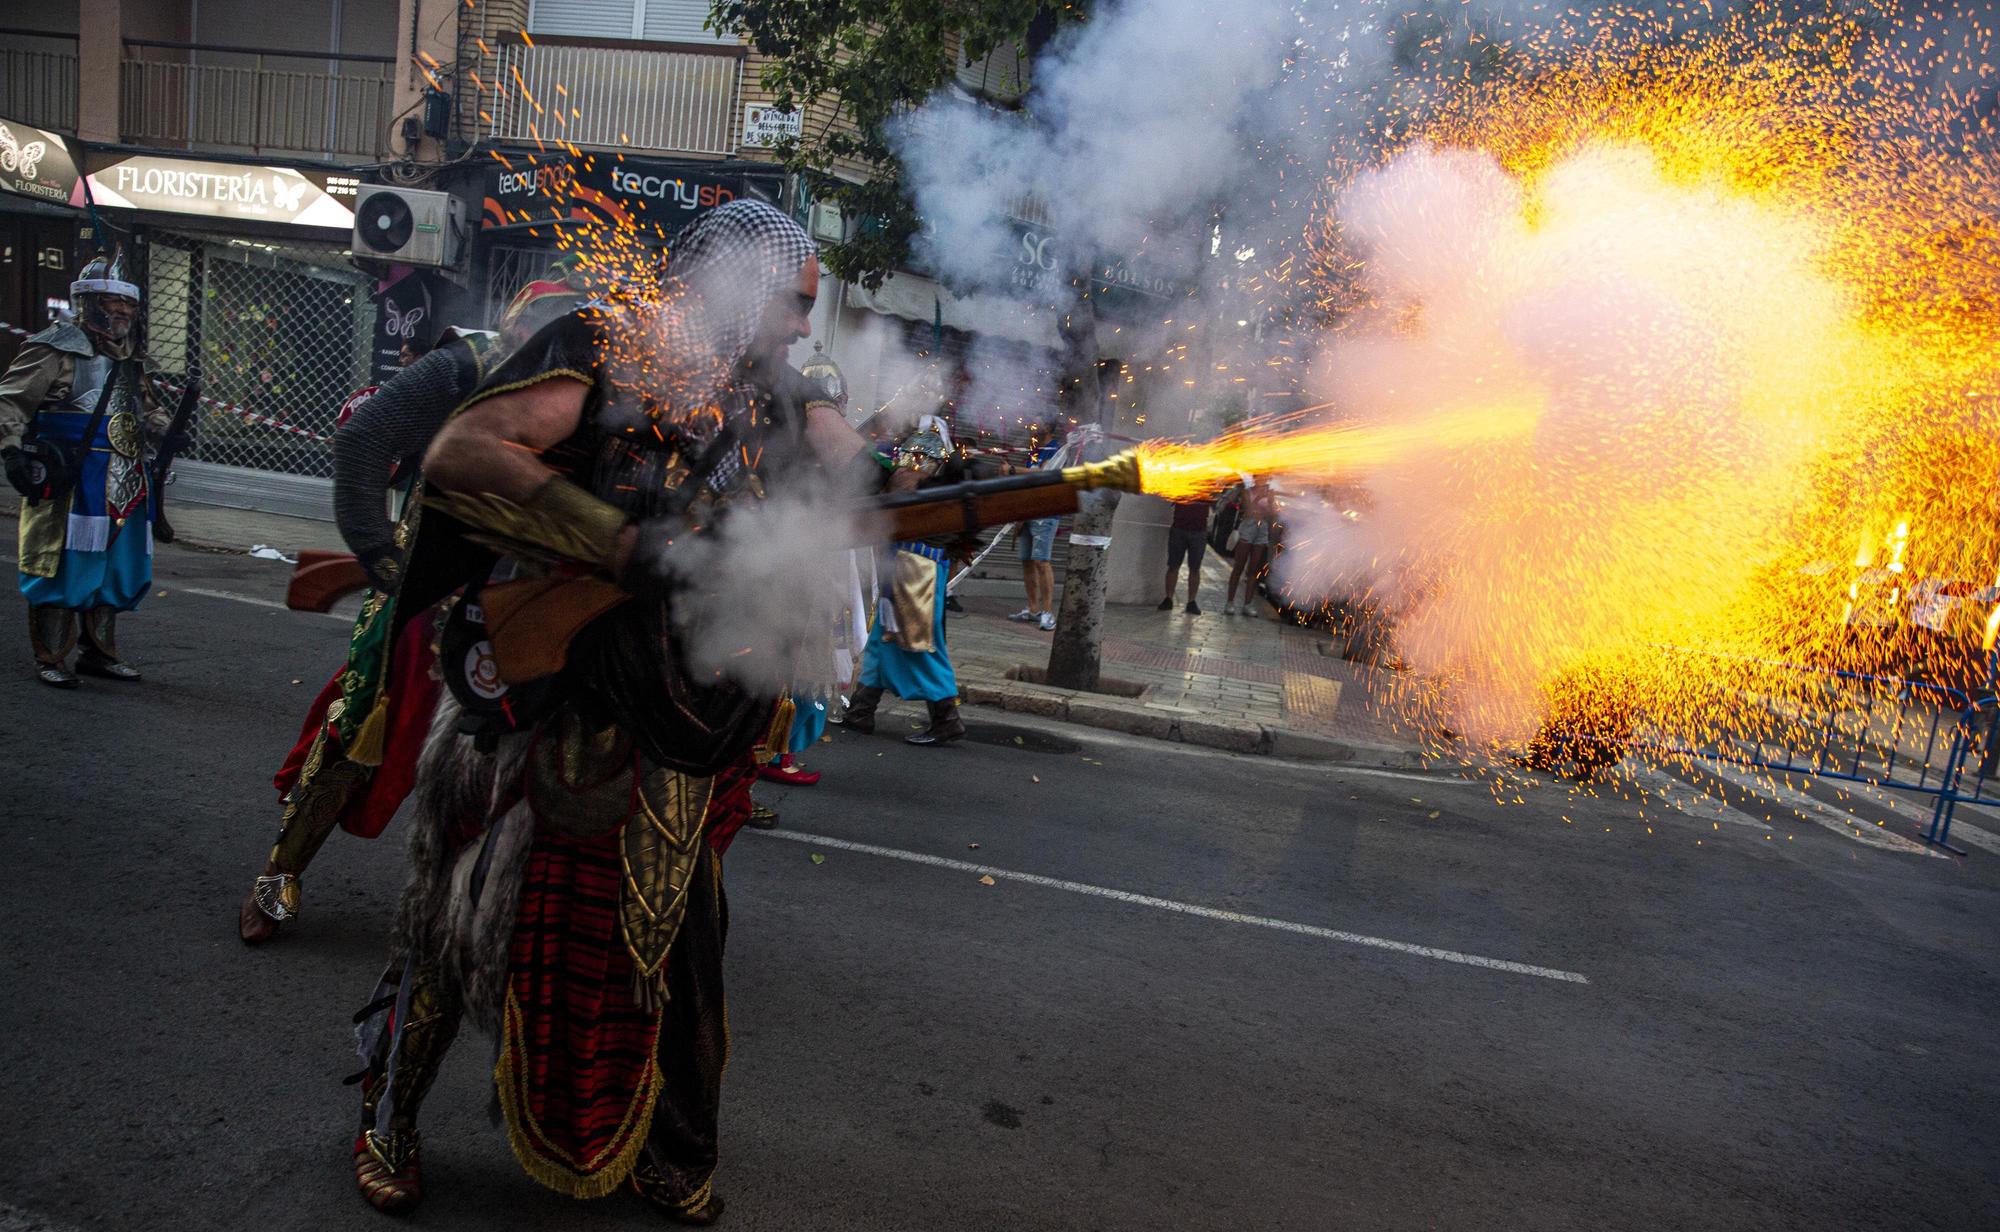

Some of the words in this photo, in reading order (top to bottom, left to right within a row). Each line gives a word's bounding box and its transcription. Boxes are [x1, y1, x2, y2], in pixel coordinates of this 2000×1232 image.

[15, 179, 68, 201] FLORISTERÍA
[116, 165, 269, 205] FLORISTERÍA
[1020, 231, 1058, 271] SG
[1104, 265, 1175, 296] BOLSOS
